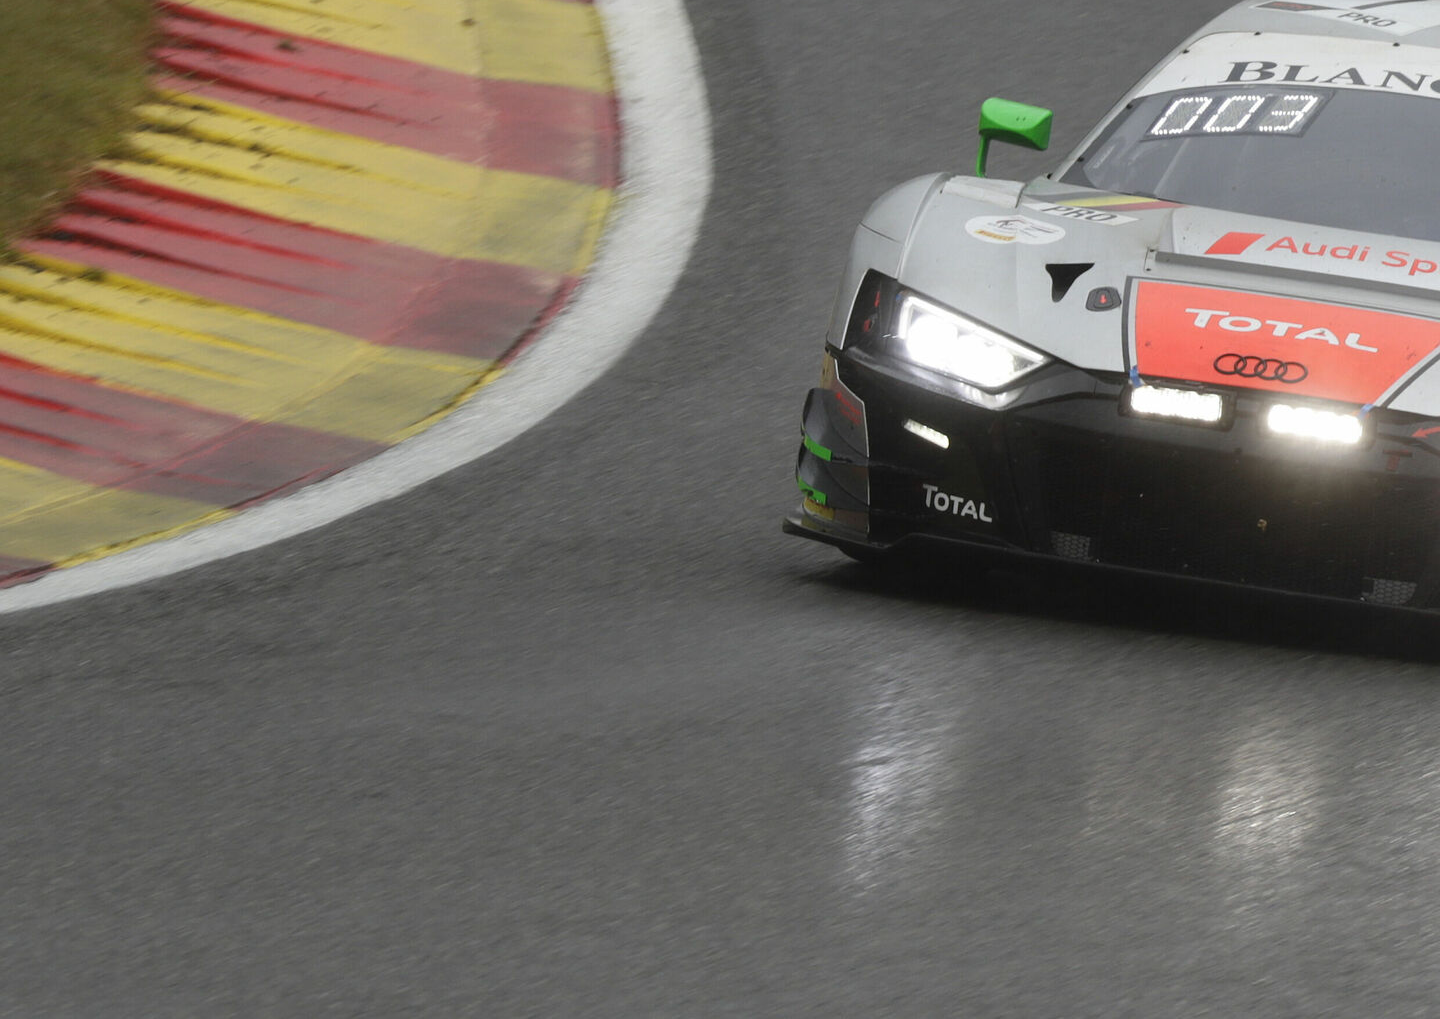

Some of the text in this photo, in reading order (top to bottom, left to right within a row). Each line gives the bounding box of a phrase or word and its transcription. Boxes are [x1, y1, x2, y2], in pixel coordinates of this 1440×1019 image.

[1337, 11, 1397, 29] PRO
[1150, 95, 1319, 136] 003
[1042, 204, 1119, 223] PRO
[1264, 235, 1373, 263] Audi
[1184, 307, 1379, 354] TOTAL
[922, 483, 993, 523] TOTAL
